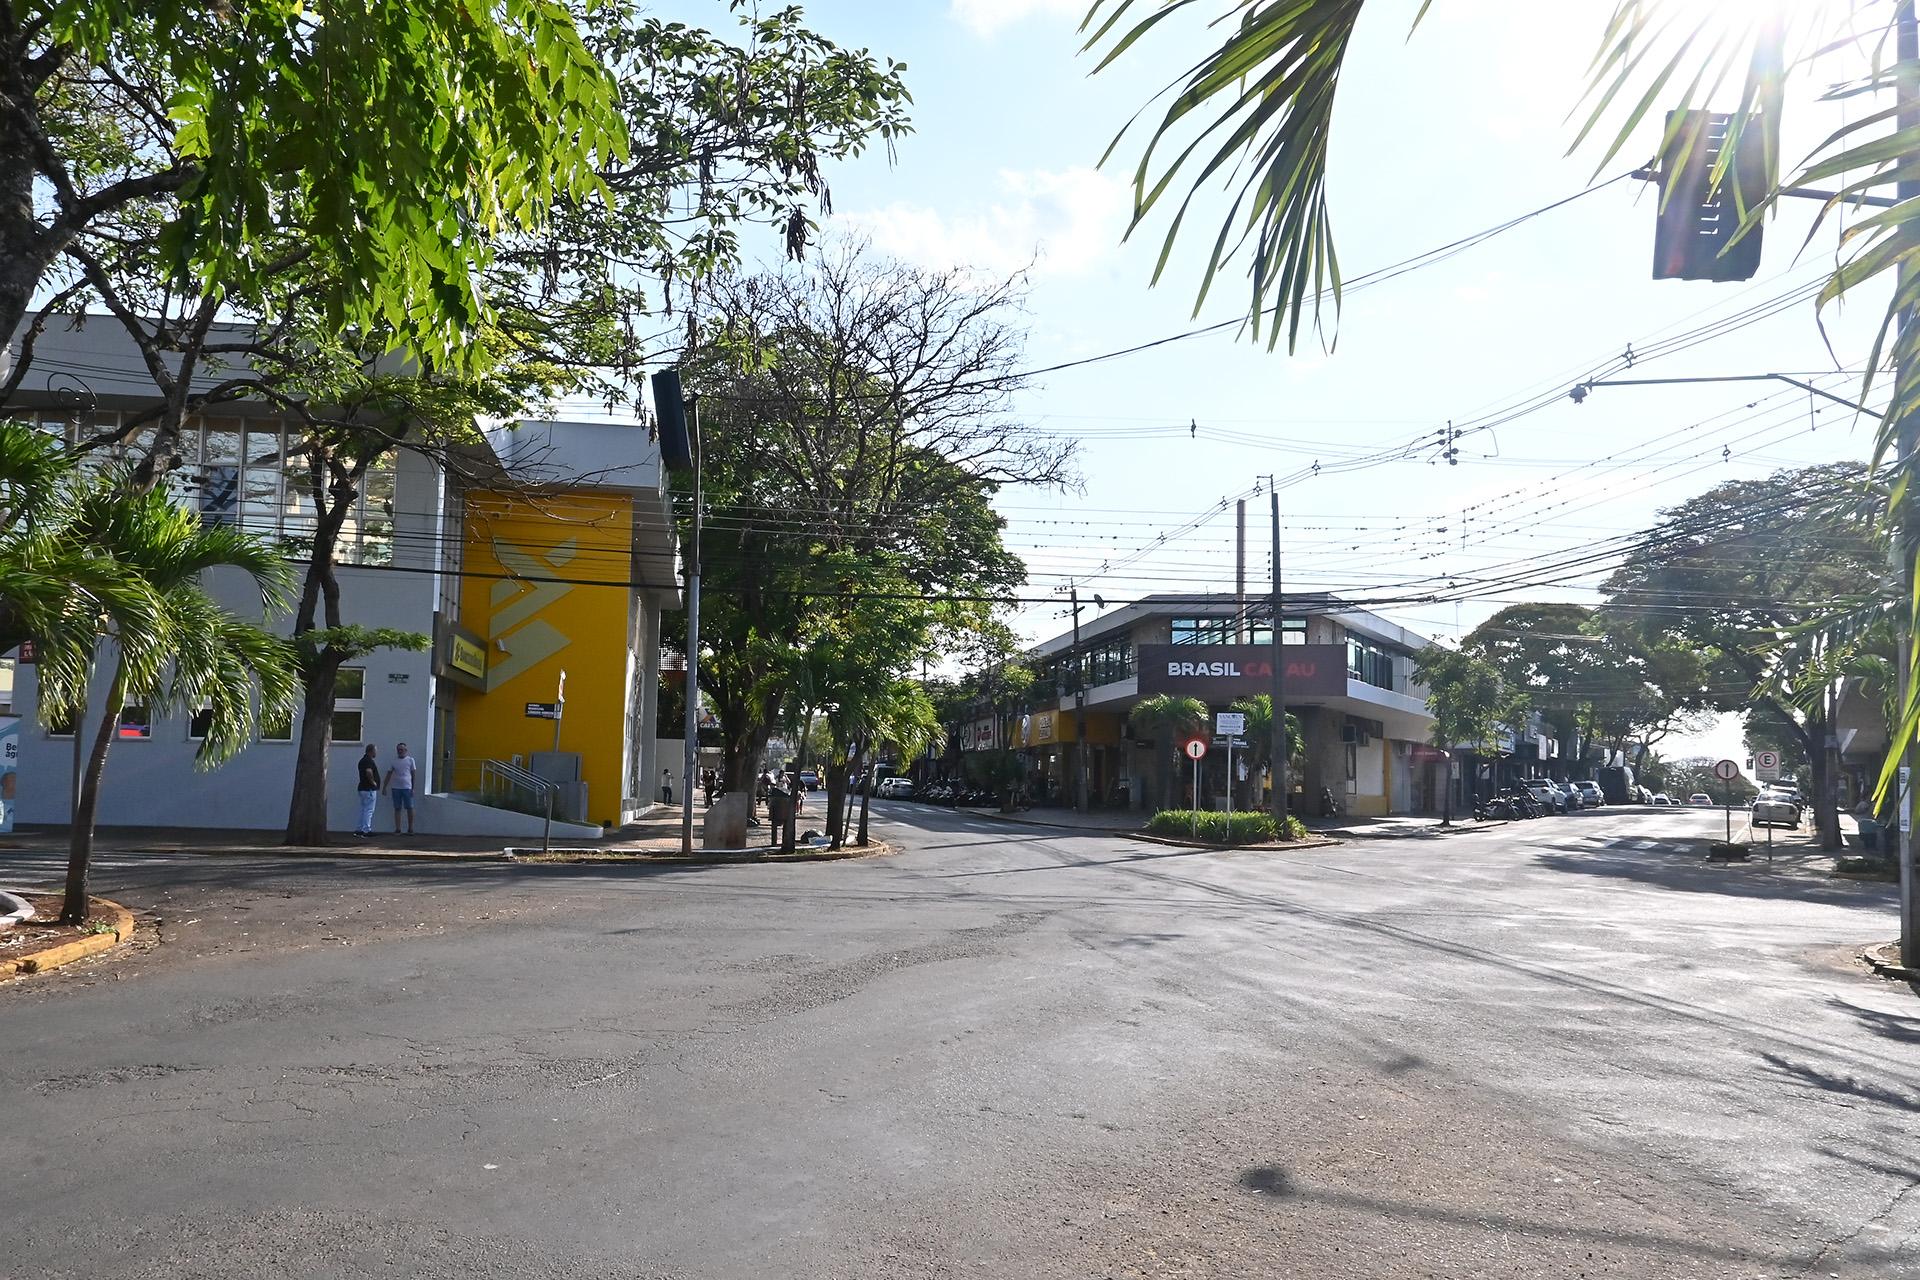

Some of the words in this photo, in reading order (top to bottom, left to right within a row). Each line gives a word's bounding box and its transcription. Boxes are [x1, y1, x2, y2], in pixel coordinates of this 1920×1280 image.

[1168, 662, 1240, 676] BRASIL
[1245, 662, 1316, 677] CAAU
[1764, 755, 1771, 764] E
